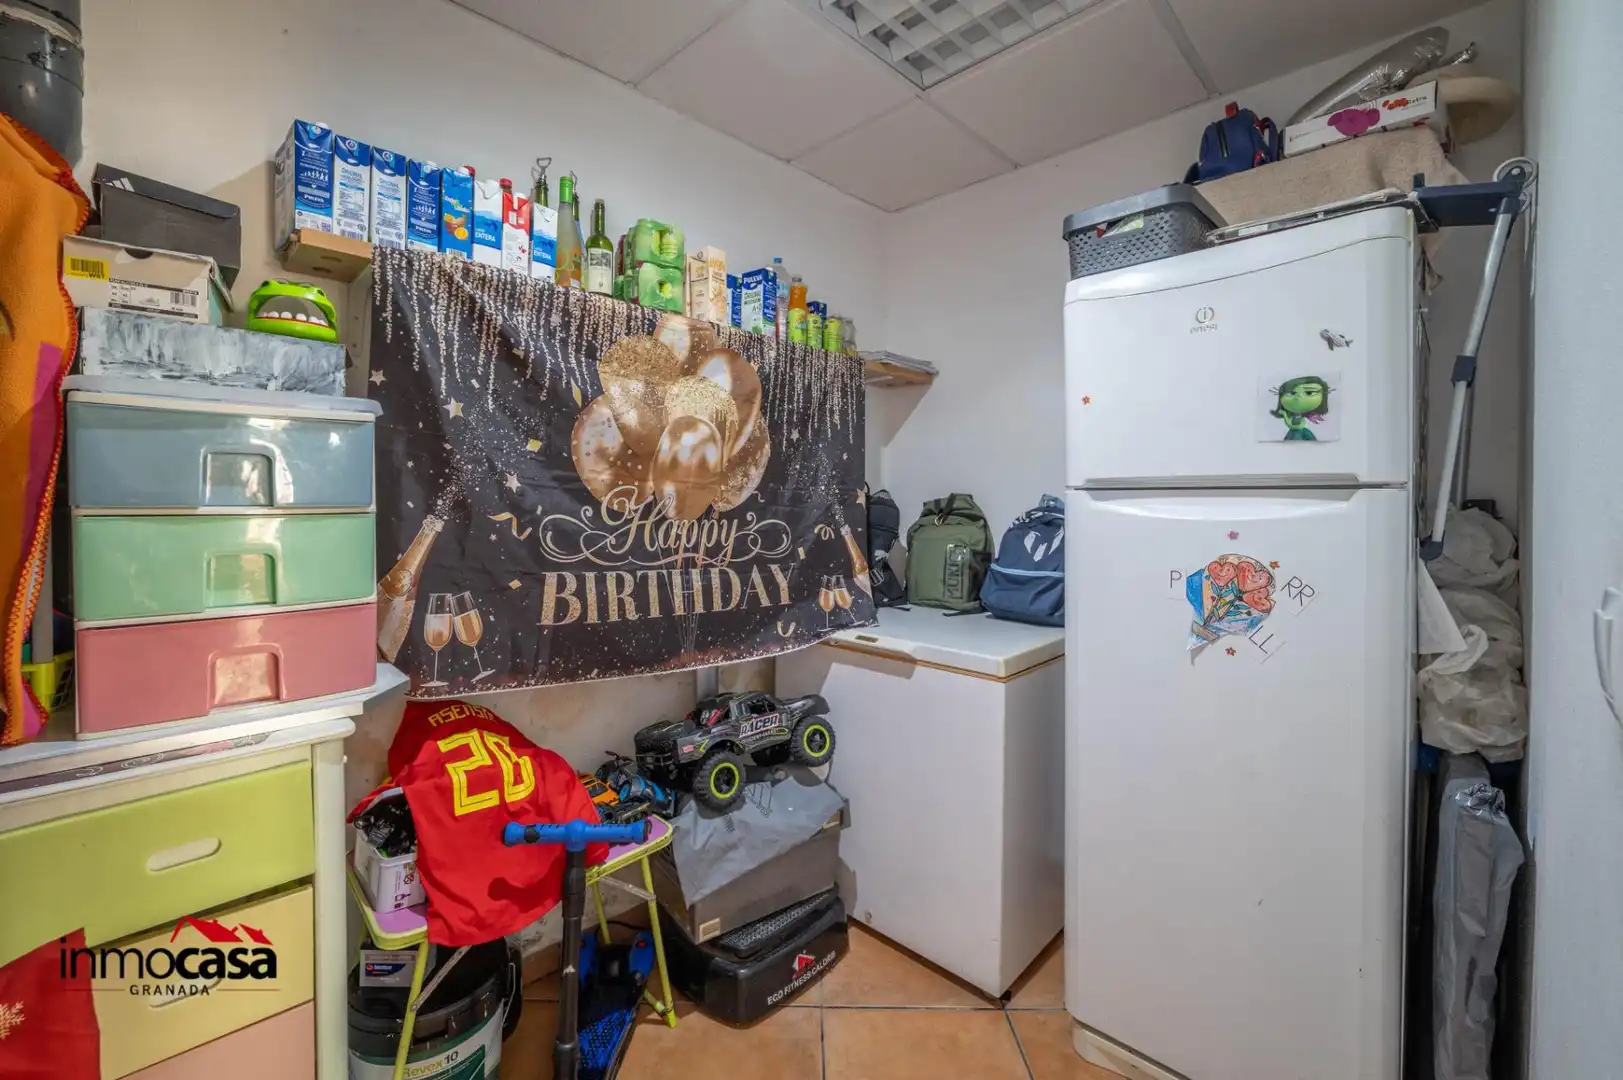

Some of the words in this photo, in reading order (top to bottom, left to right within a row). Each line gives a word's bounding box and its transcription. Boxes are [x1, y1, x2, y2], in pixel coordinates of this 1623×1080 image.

[474, 231, 496, 242] ENTERA
[533, 250, 552, 260] ENTERA
[601, 485, 738, 568] Happy
[536, 562, 796, 626] BIRTHDAY
[767, 990, 784, 1005] ECO
[784, 971, 812, 996] FITNESS
[444, 1051, 459, 1066] 10
